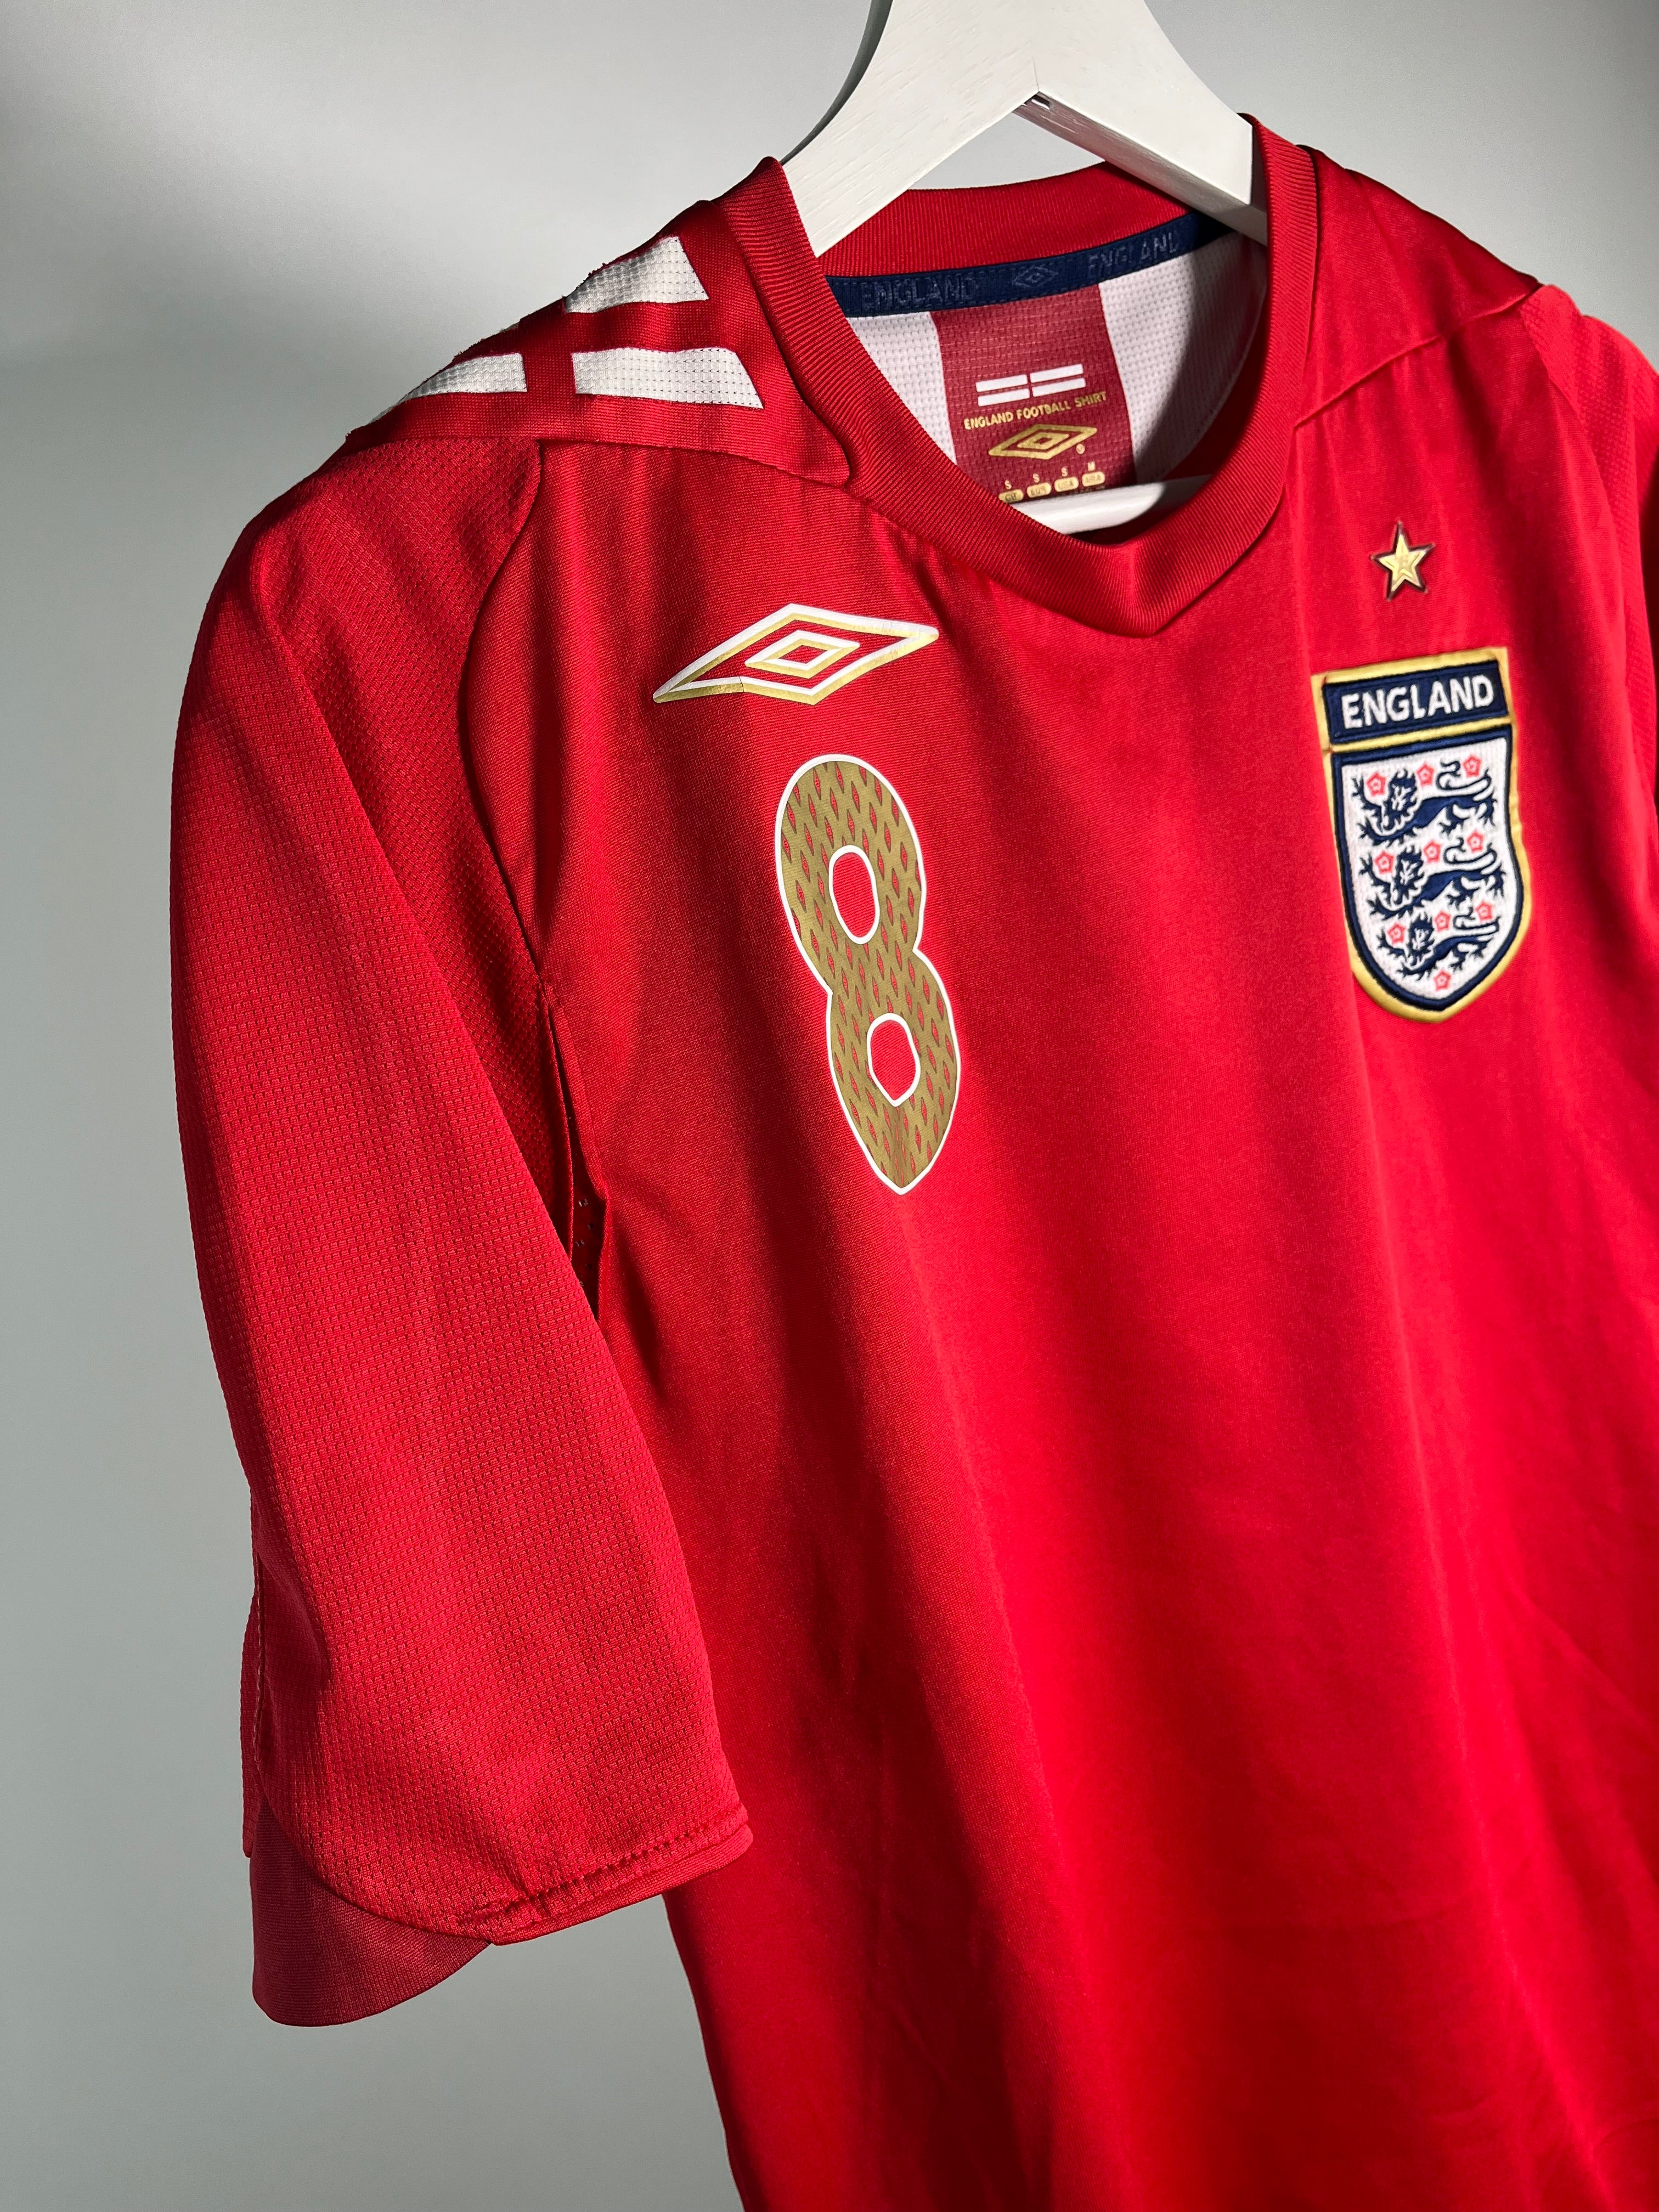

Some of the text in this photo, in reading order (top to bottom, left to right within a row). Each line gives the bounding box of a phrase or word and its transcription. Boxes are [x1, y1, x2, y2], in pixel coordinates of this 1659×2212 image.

[862, 276, 979, 308] ENGLAND
[963, 391, 1107, 430] ENGLAND FOOTBALL SHIRT
[1004, 479, 1012, 490] S
[1032, 473, 1040, 483] S
[1061, 467, 1068, 477] S
[1058, 480, 1074, 489] USA
[1341, 674, 1494, 729] ENGLAND
[774, 753, 961, 1195] 8
